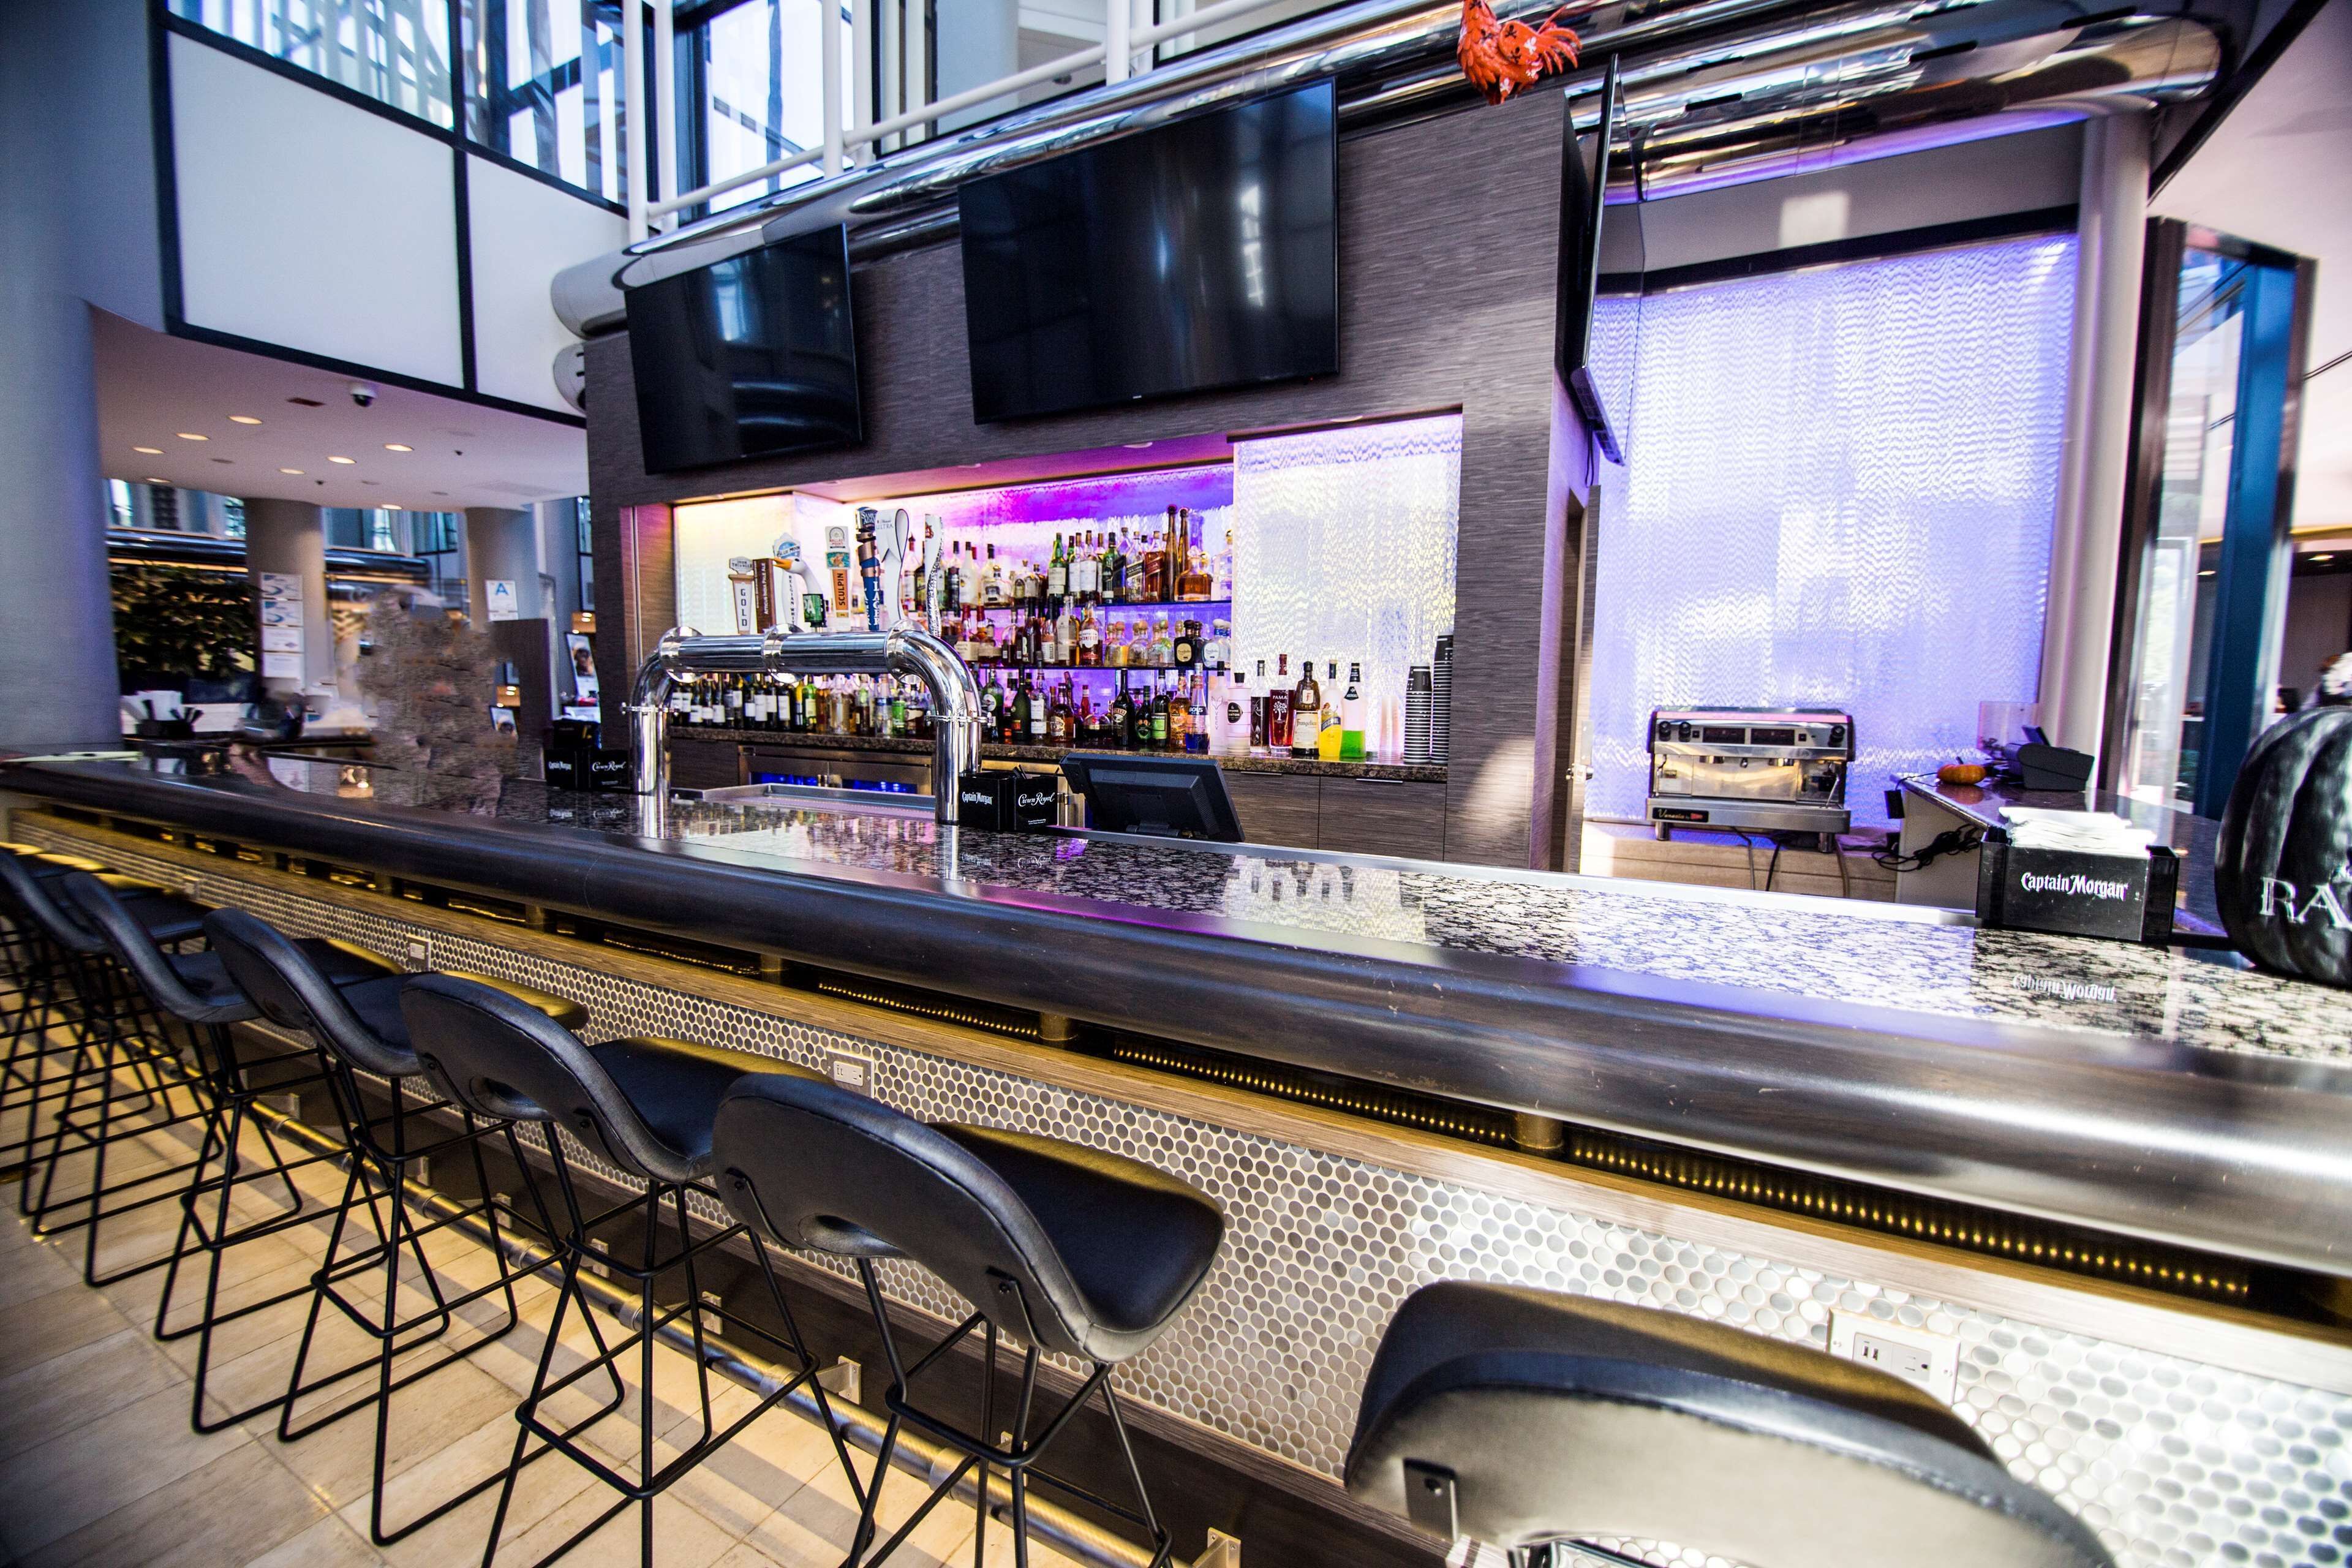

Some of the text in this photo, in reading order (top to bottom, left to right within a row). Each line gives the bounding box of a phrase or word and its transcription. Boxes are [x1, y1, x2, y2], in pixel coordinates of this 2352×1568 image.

[495, 582, 509, 595] A
[592, 761, 627, 771] Crown Royal
[962, 791, 993, 805] Captain Morgan
[1018, 792, 1055, 807] Crown Royal
[2021, 872, 2128, 901] Captain Morgan
